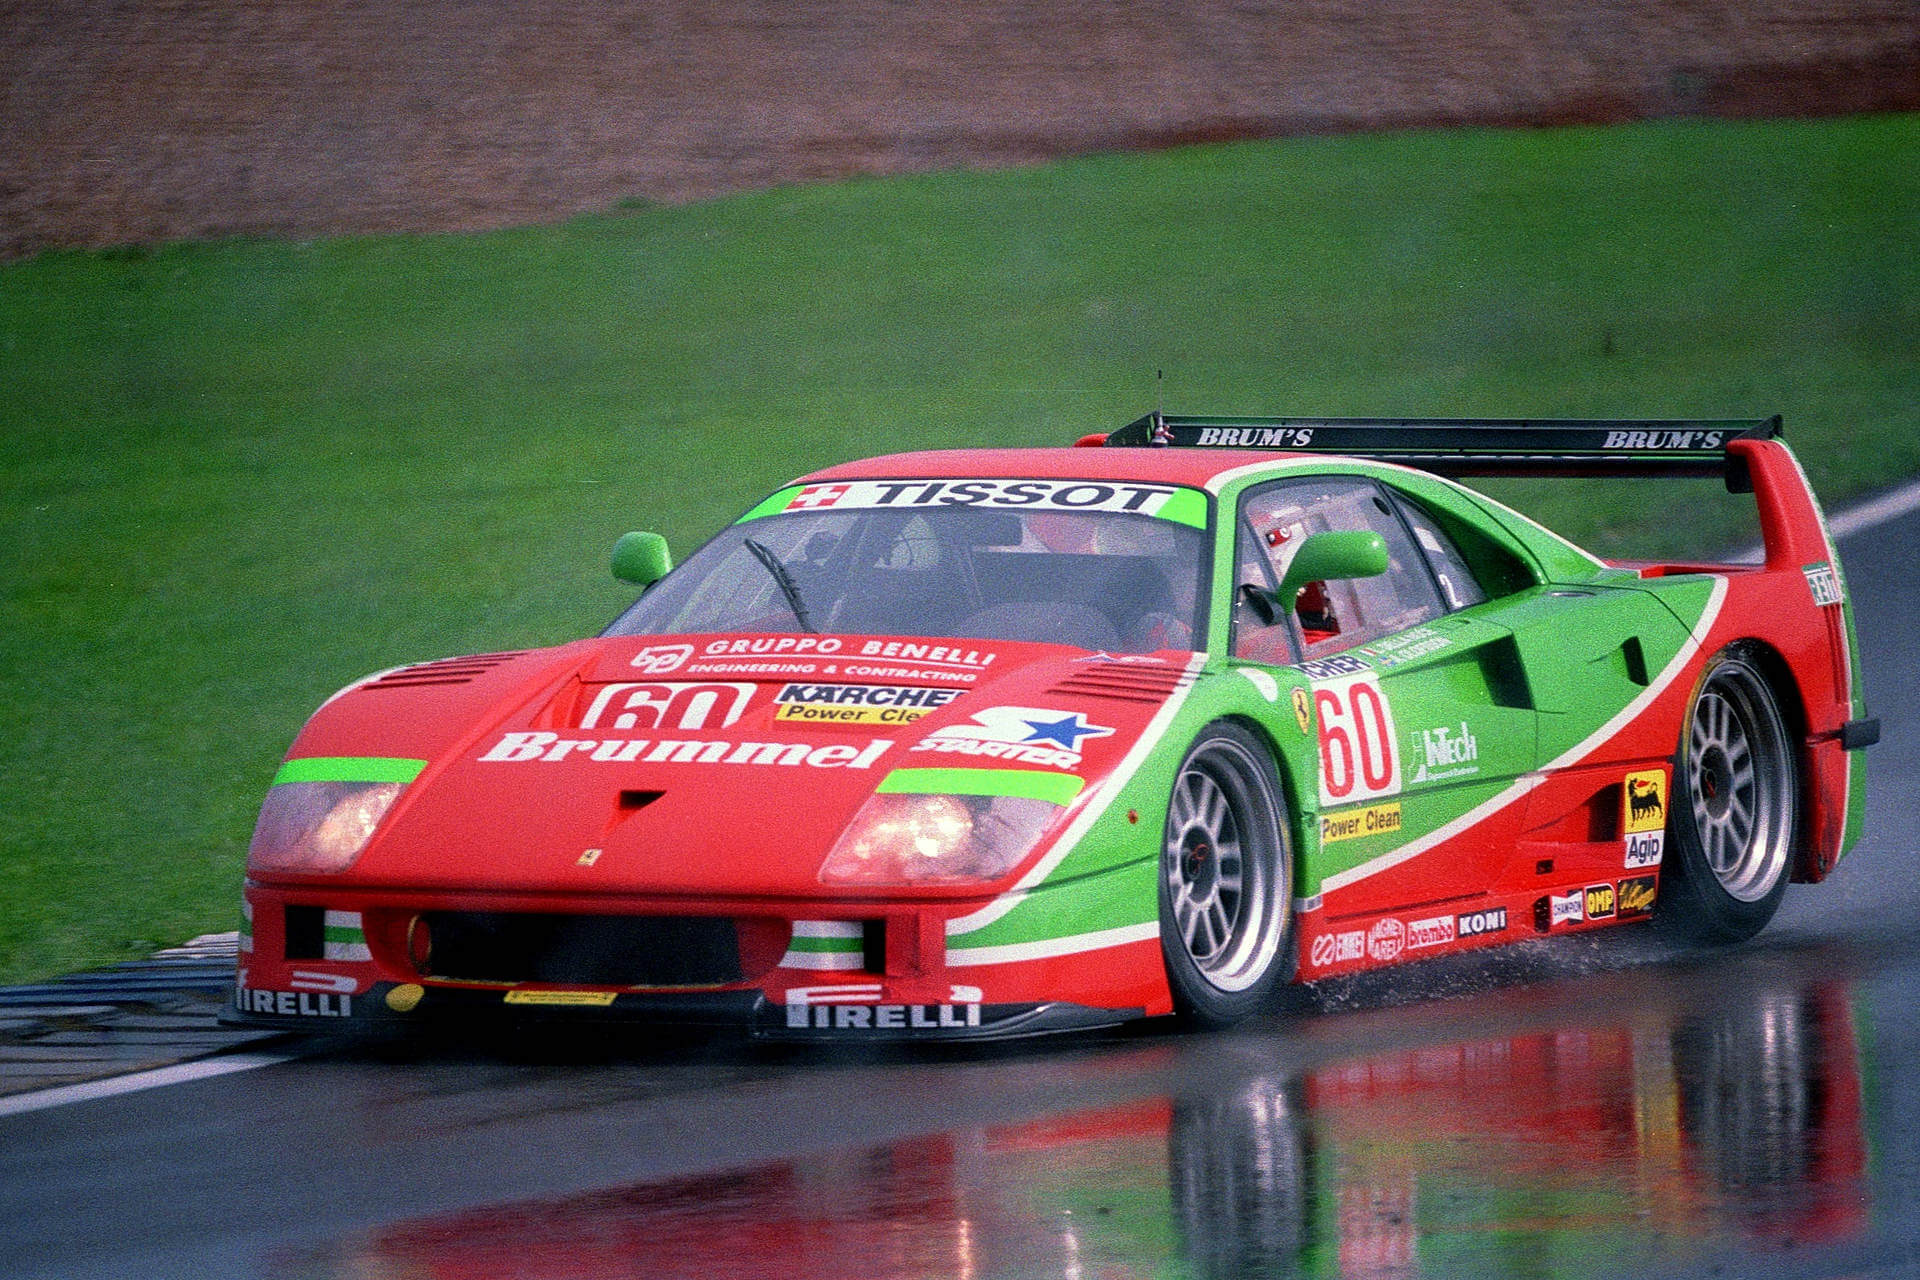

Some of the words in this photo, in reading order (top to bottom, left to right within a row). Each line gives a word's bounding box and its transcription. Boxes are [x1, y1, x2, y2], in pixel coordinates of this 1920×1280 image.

[1197, 428, 1314, 446] BRUM'S
[1602, 431, 1723, 448] BRUM'S
[875, 482, 1177, 512] TISSOT
[705, 638, 842, 655] GRUPPO
[861, 641, 997, 666] BENELLI
[687, 663, 816, 674] ENGINEERING
[823, 665, 837, 674] &
[845, 666, 977, 682] CONTRACTING
[778, 685, 968, 707] KÄRCHE
[786, 705, 867, 721] Power
[880, 708, 921, 723] Cle
[477, 732, 895, 768] Brummel
[1314, 682, 1393, 798] 60
[909, 738, 1082, 770] STARTER
[1322, 817, 1360, 840] Power
[1366, 810, 1400, 831] Clean
[1627, 834, 1659, 864] Agip
[1587, 890, 1613, 914] OMP
[1459, 911, 1506, 935] KONI
